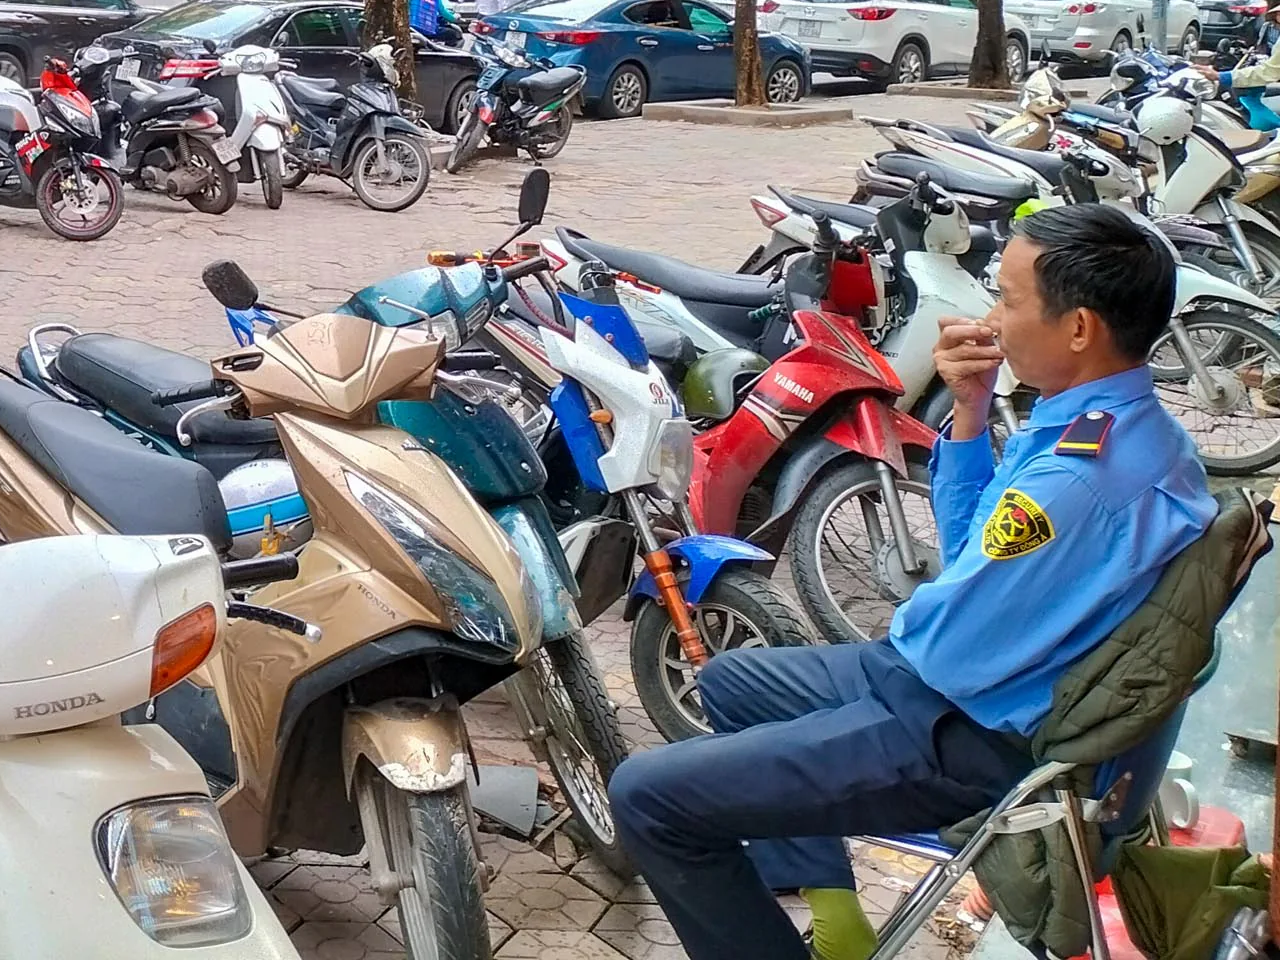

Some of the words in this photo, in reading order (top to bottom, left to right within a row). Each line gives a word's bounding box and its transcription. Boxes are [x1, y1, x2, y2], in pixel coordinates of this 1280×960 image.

[773, 372, 815, 404] YAMAHA
[1014, 495, 1044, 522] SECURITY
[356, 582, 398, 620] HONDA
[14, 691, 106, 720] HONDA
